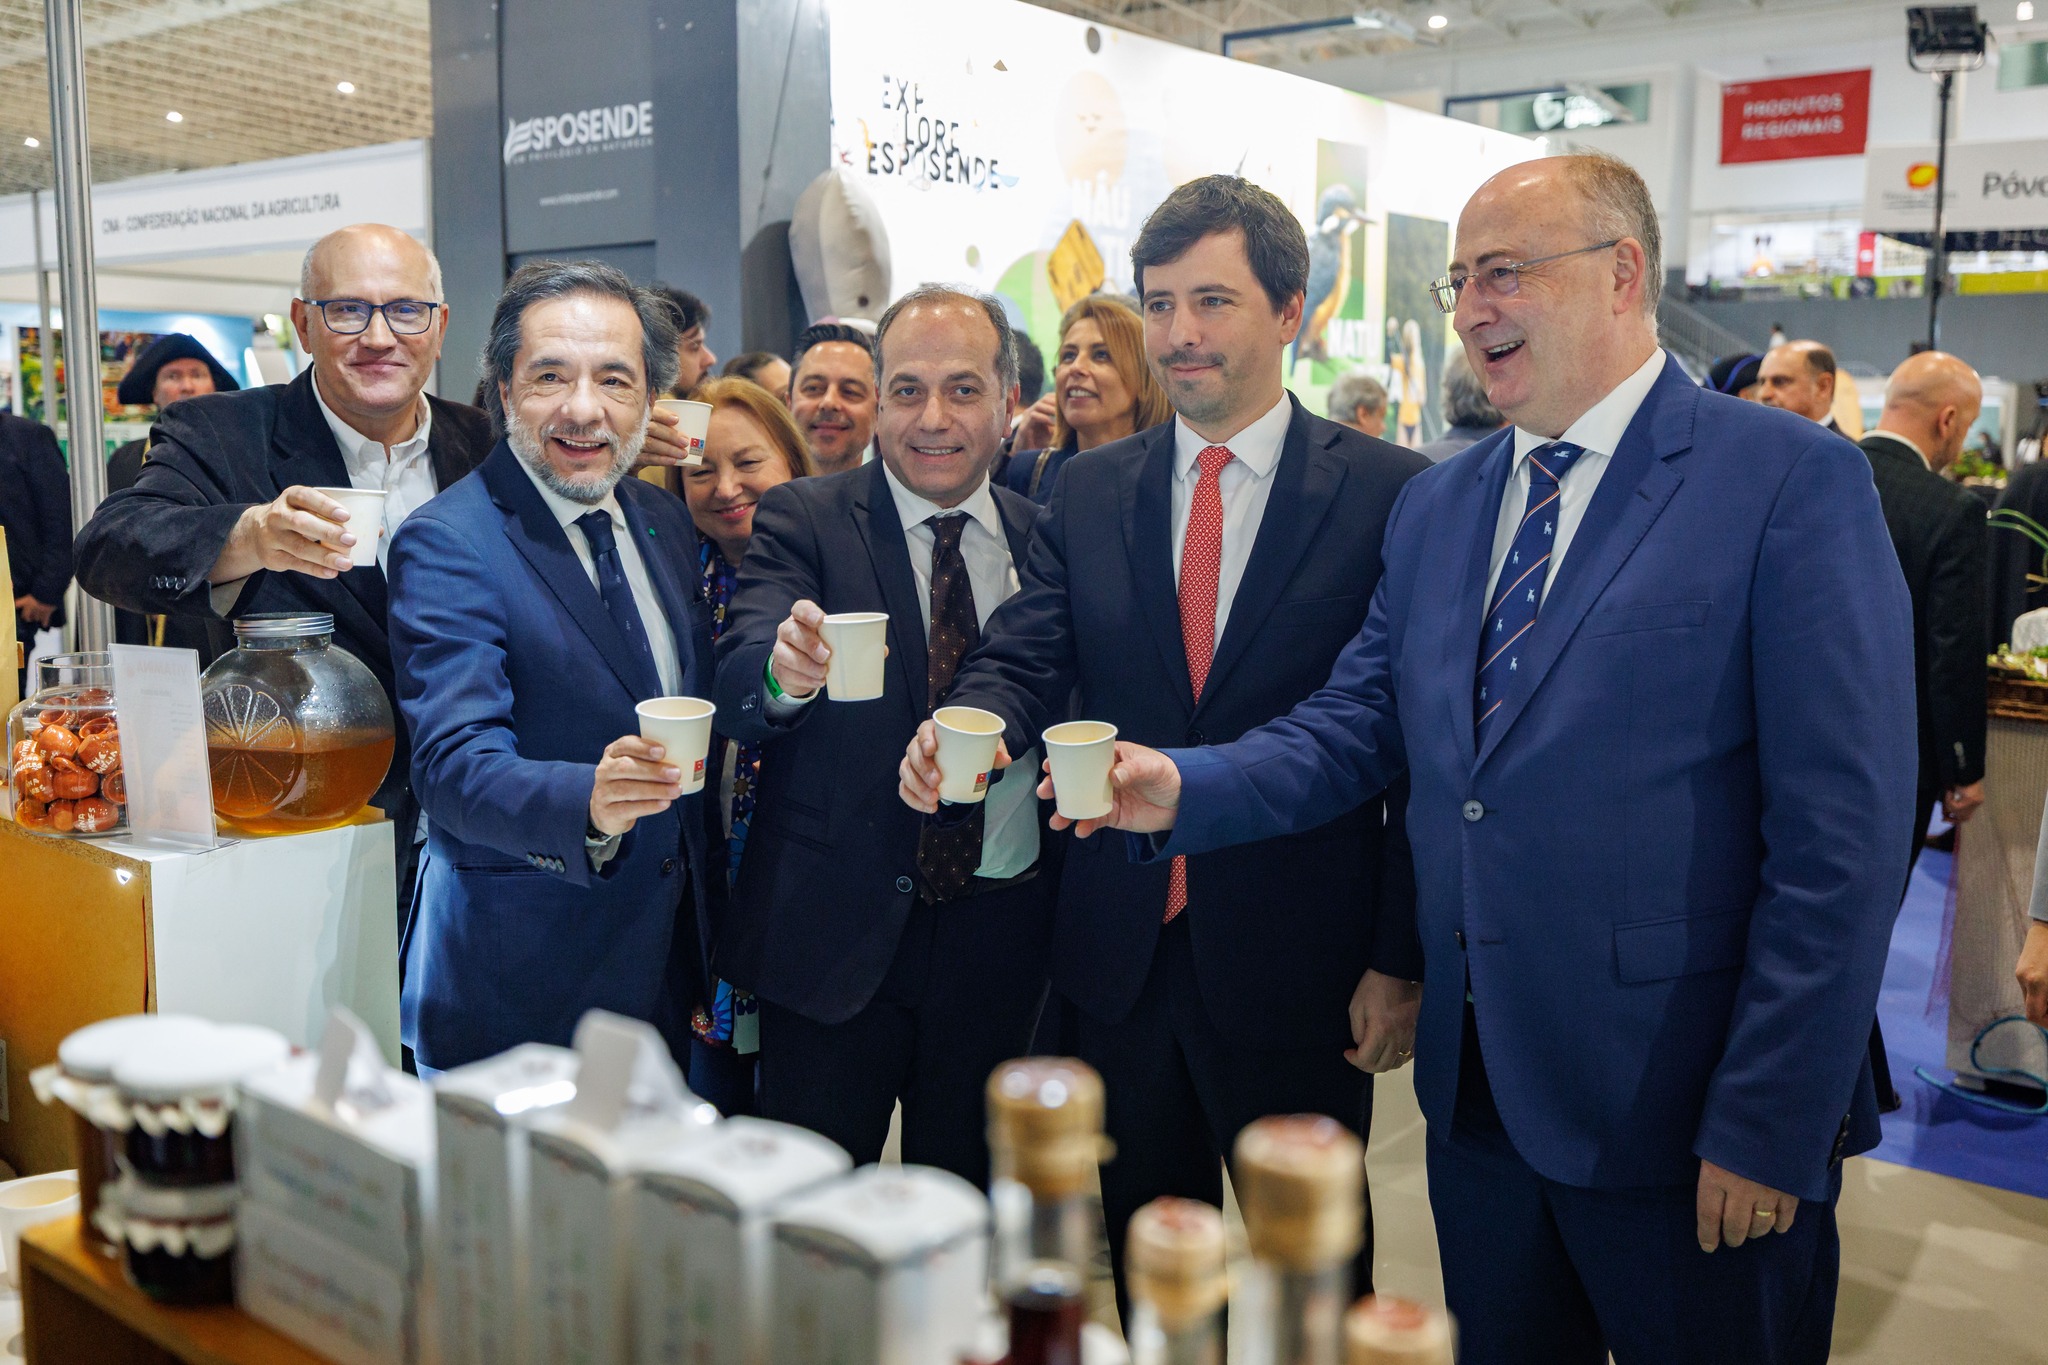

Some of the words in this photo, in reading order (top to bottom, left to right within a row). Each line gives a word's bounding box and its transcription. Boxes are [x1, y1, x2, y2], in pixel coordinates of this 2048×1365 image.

[1743, 93, 1844, 119] PRODUTOS
[503, 101, 653, 166] ESPOSENDE
[1741, 115, 1844, 140] REGIONAIS
[867, 142, 999, 189] ESPOSENDE
[102, 216, 120, 235] CNA
[126, 206, 199, 231] CONFEDERAÇÃO
[200, 204, 249, 224] NACIONAL
[251, 200, 265, 219] DA
[267, 193, 341, 216] AGRICULTURA
